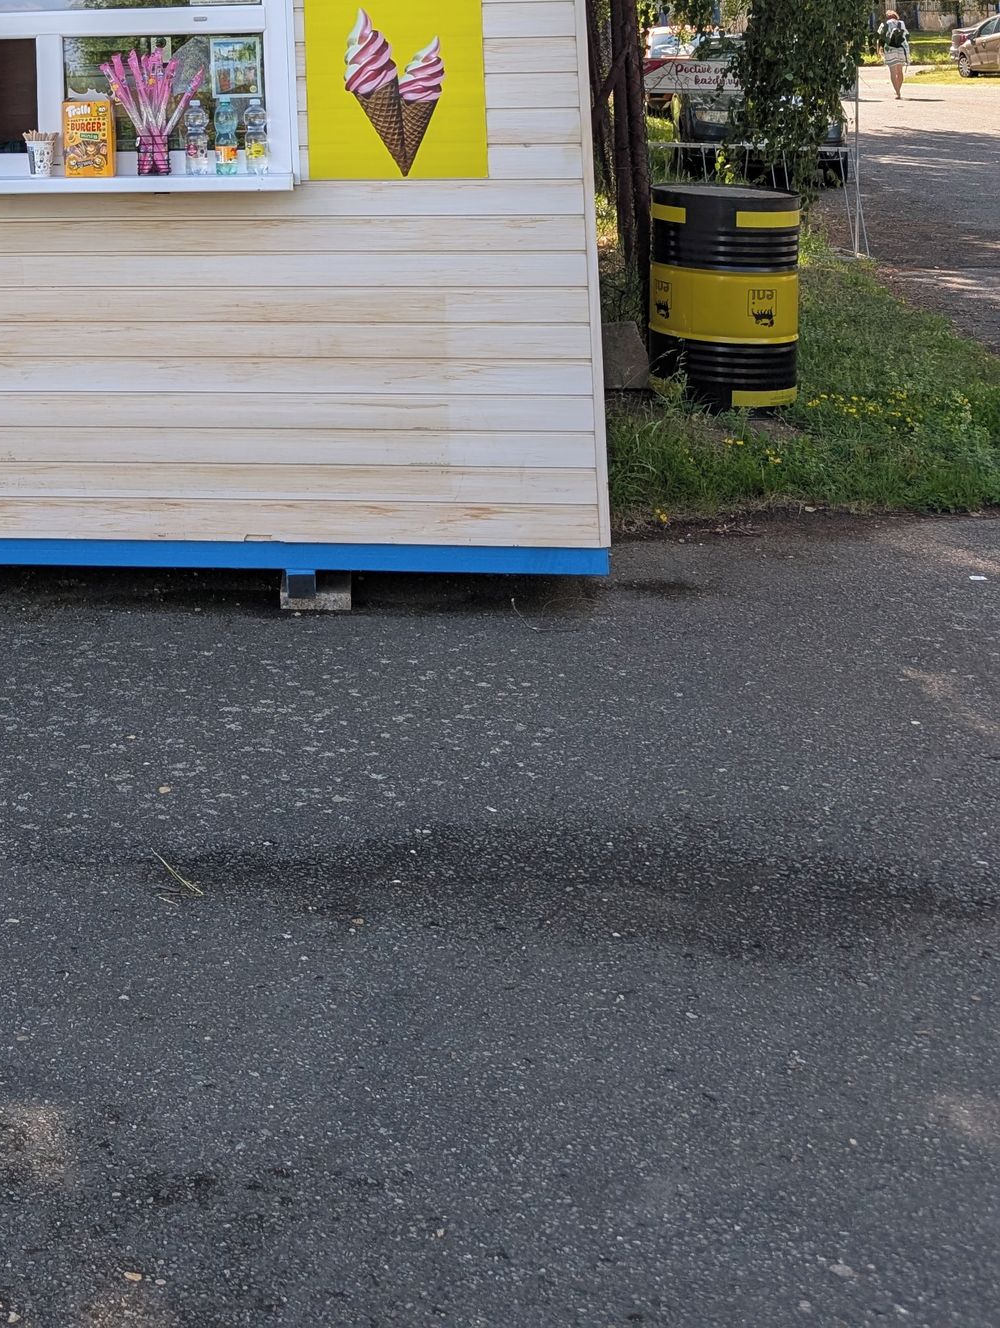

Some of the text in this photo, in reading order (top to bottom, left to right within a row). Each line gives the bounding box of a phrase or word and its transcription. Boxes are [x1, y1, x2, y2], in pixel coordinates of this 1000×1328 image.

[66, 103, 91, 118] Trolli
[71, 122, 102, 132] BURGER
[752, 289, 774, 305] eni
